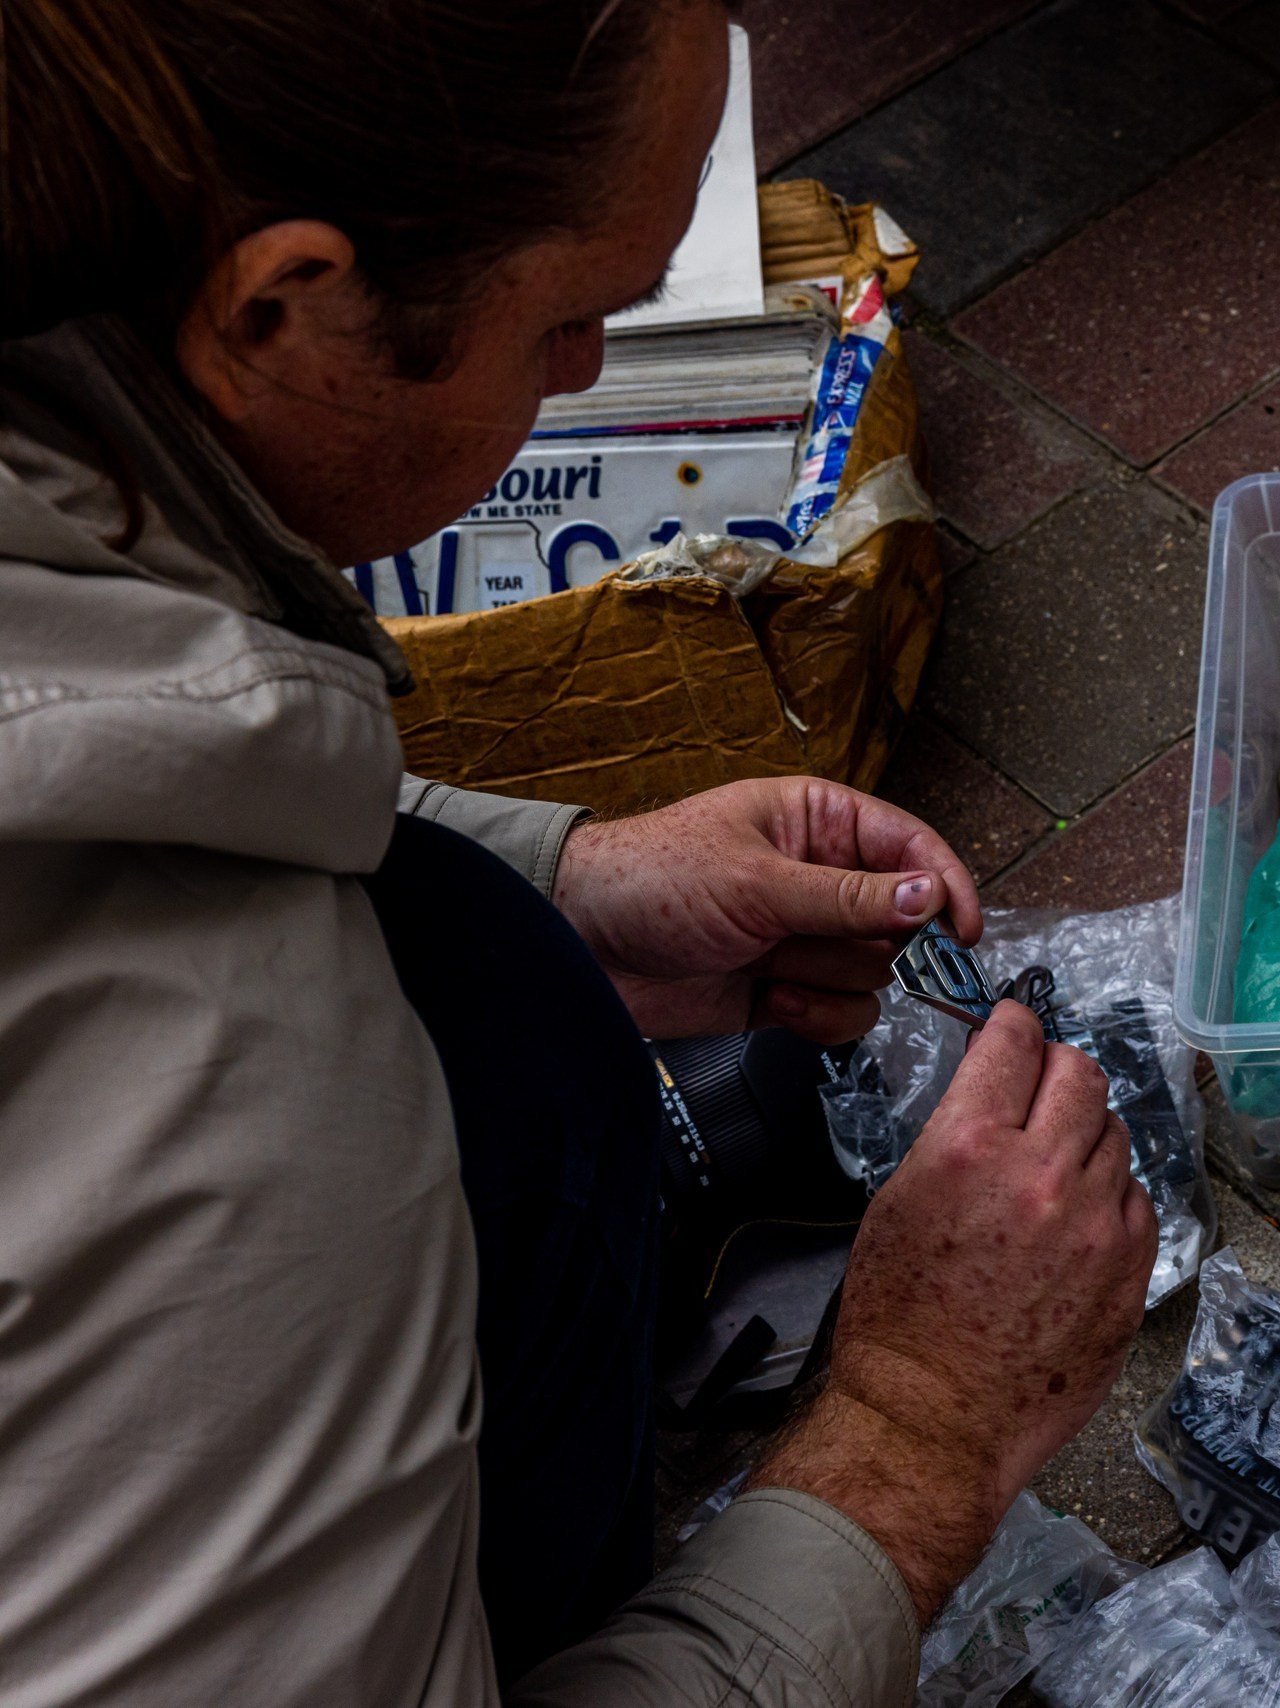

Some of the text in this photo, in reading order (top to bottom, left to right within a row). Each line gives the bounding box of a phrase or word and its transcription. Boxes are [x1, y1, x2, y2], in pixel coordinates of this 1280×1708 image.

[483, 456, 602, 503] ouri
[487, 506, 509, 518] ME
[514, 503, 562, 517] STATE
[484, 575, 524, 591] YEAR
[820, 1051, 840, 1084] SIGMA
